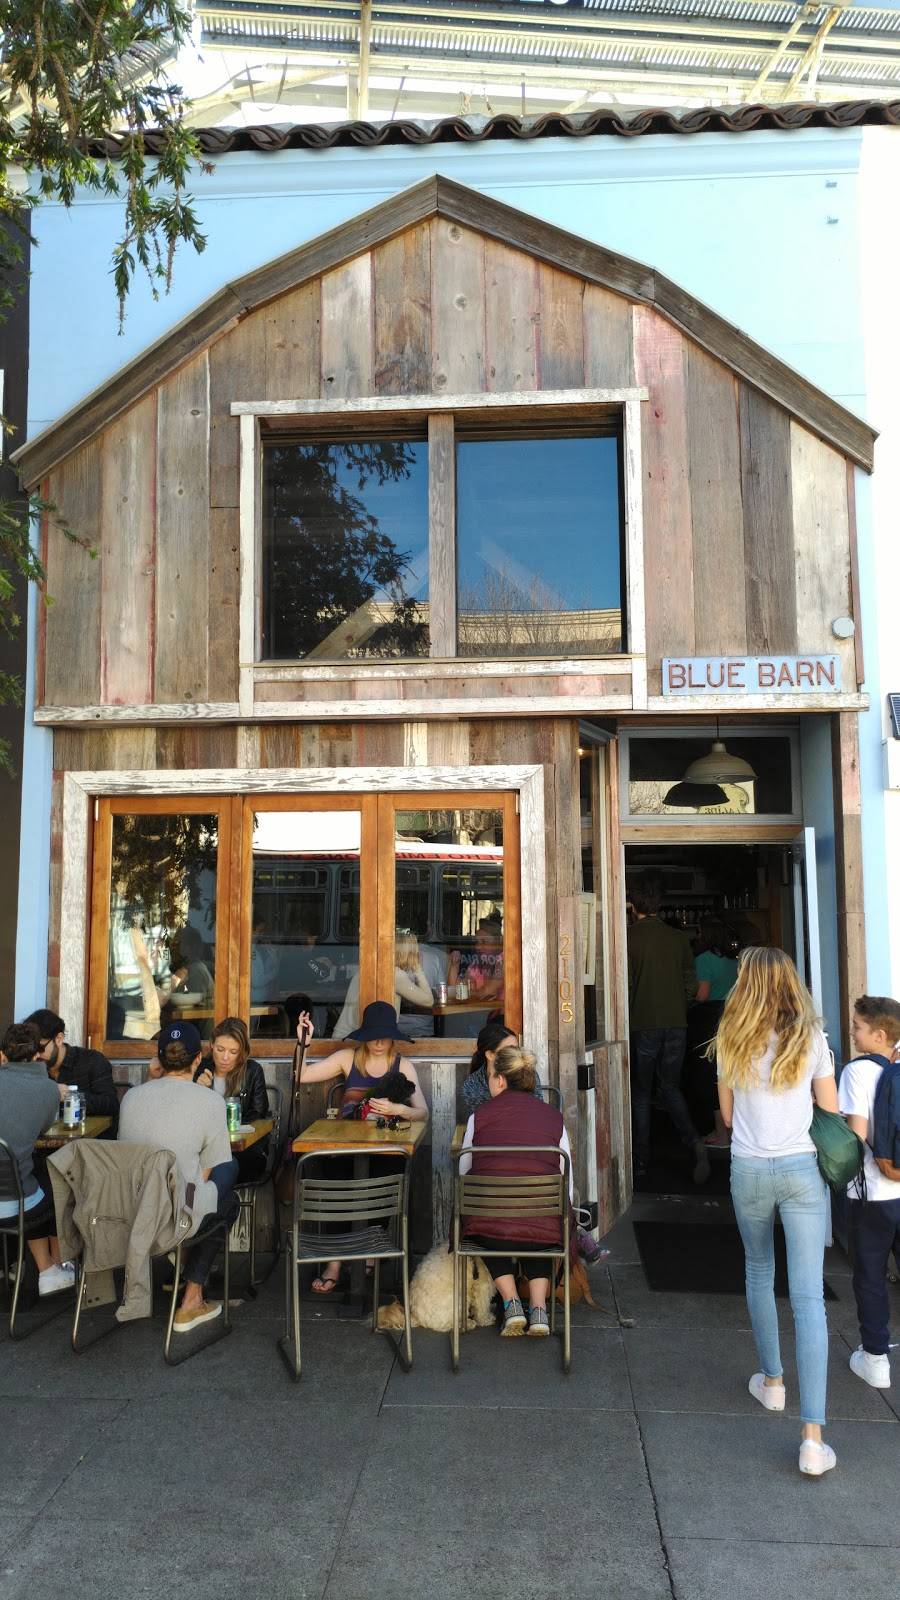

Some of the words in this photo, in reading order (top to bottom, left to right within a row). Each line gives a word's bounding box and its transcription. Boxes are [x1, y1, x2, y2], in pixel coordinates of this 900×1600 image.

[668, 663, 745, 689] BLUE
[758, 660, 835, 687] BARN
[559, 934, 573, 1023] 2105
